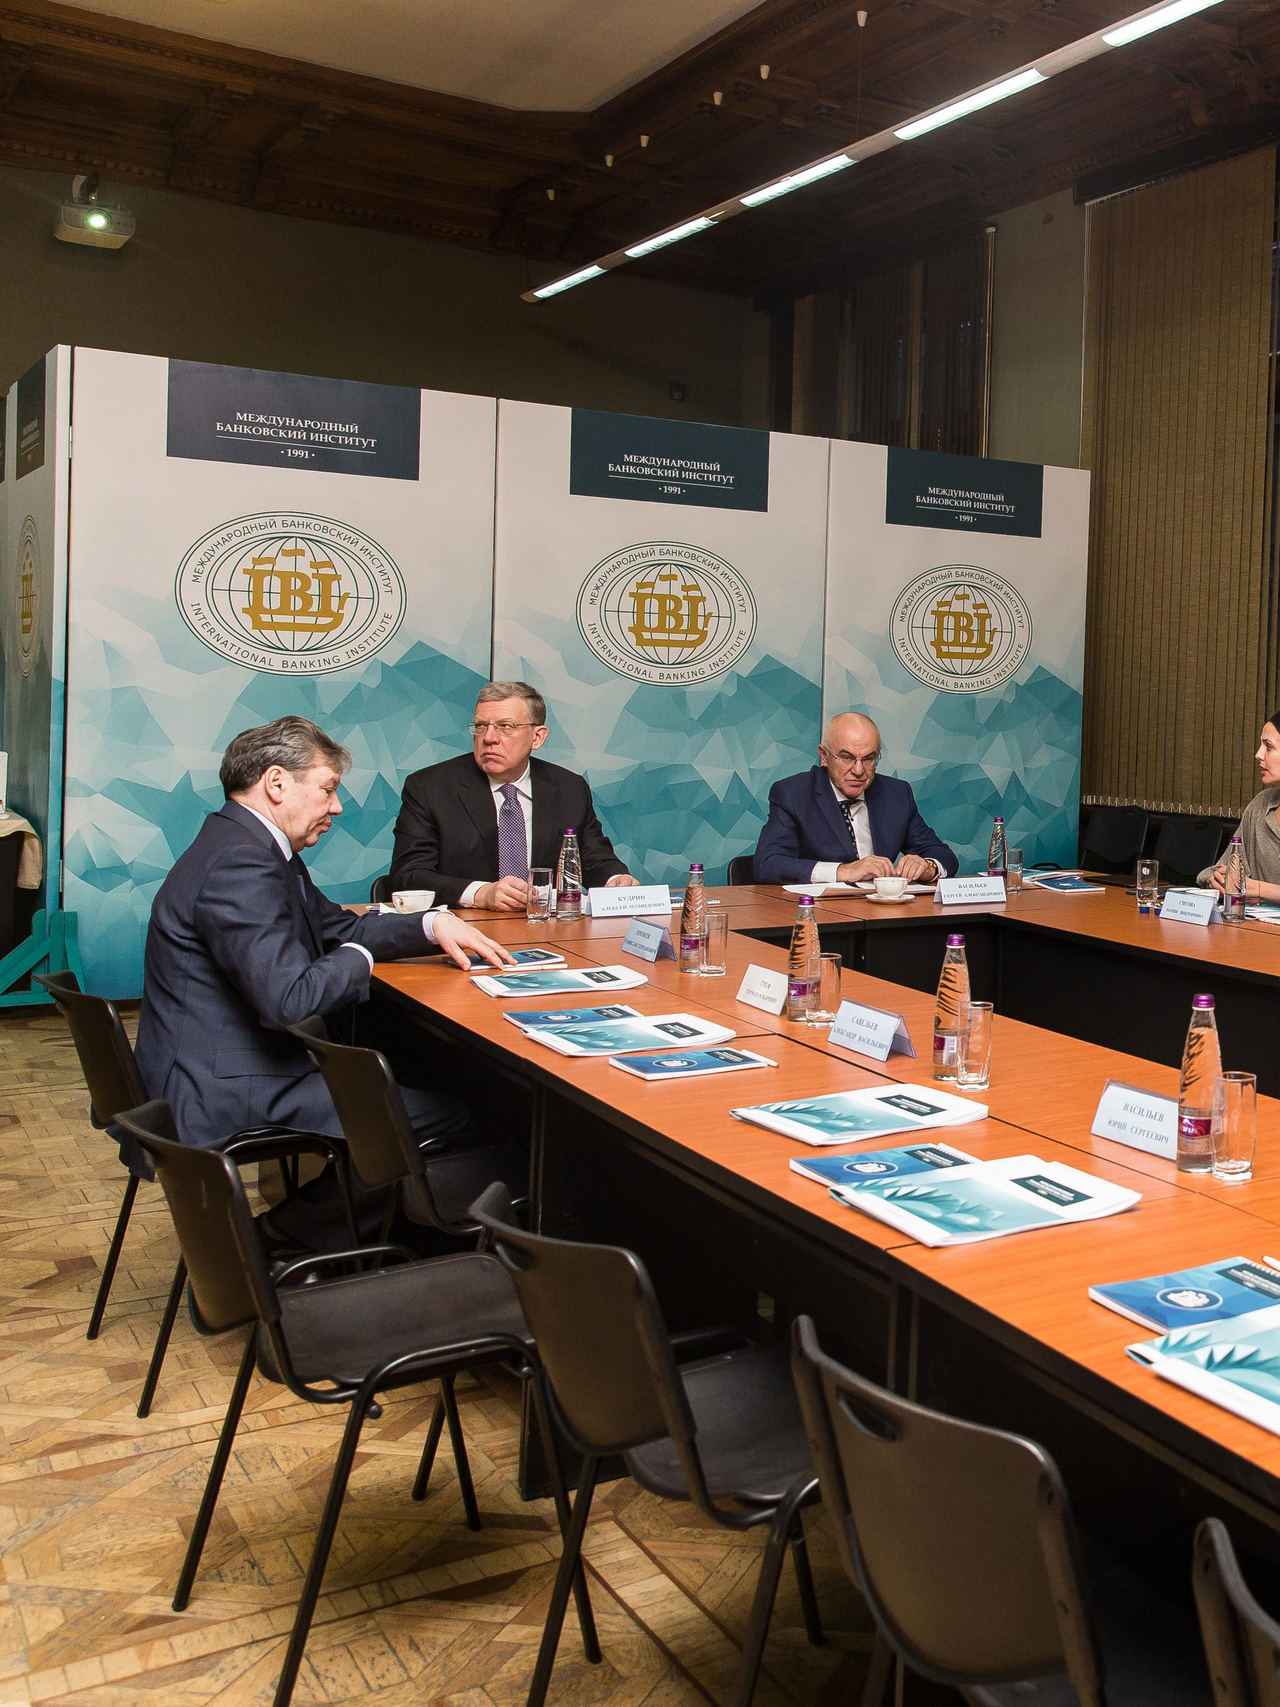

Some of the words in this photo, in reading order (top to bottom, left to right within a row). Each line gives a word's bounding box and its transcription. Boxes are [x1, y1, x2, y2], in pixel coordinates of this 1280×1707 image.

[216, 422, 306, 440] БАНКОВСКИЙ
[309, 433, 377, 448] ИНСТИТУТ
[236, 412, 359, 433] МЕЖДУНАРОДНЫЙ
[608, 463, 679, 478] БАНКОВСКИЙ
[681, 471, 735, 484] ИНСТИТУТ
[623, 453, 721, 472] МЕЖДУНАРОДНЫЙ
[916, 495, 972, 508] БАНКОВСКИЙ
[973, 502, 1015, 513] ИНСТИТУТ
[928, 486, 1004, 502] МЕЖДУНАРОДНЫЙ
[191, 519, 277, 583] МЕЖДУНАРОДНЫЙ
[281, 519, 360, 548] БАНКОВСКИЙ
[359, 544, 393, 595] ИНСТИТУТ
[589, 547, 656, 606] МЕЖДУНАРОДНЫЙ
[659, 548, 721, 573] БАНКОВСКИЙ
[720, 569, 747, 614] ИНСТИТУТ
[899, 570, 953, 622] МЕЖДУНАРОДНЫЙ
[955, 570, 1004, 592] БАНКОВСКИЙ
[1003, 590, 1025, 629] ИНСТИТУТ
[190, 602, 274, 667] INTERNATIONAL
[281, 655, 341, 669] BANKING
[345, 612, 393, 659] INSTITUTE
[588, 622, 654, 679] INTERNATIONAL
[658, 668, 706, 680] BANKING
[708, 629, 747, 671] INSTITUTE
[898, 637, 950, 688] INTERNATIONAL
[954, 677, 992, 689] BANKING
[993, 643, 1024, 681] INSTITUTE
[851, 1016, 878, 1031] САВЕЛЬЕВ
[1123, 1102, 1165, 1122] ВАСИЛЬЕВ
[1107, 1119, 1127, 1131] ЮРИЙ
[1130, 1125, 1170, 1144] СЕРГЕЕВИЧ
